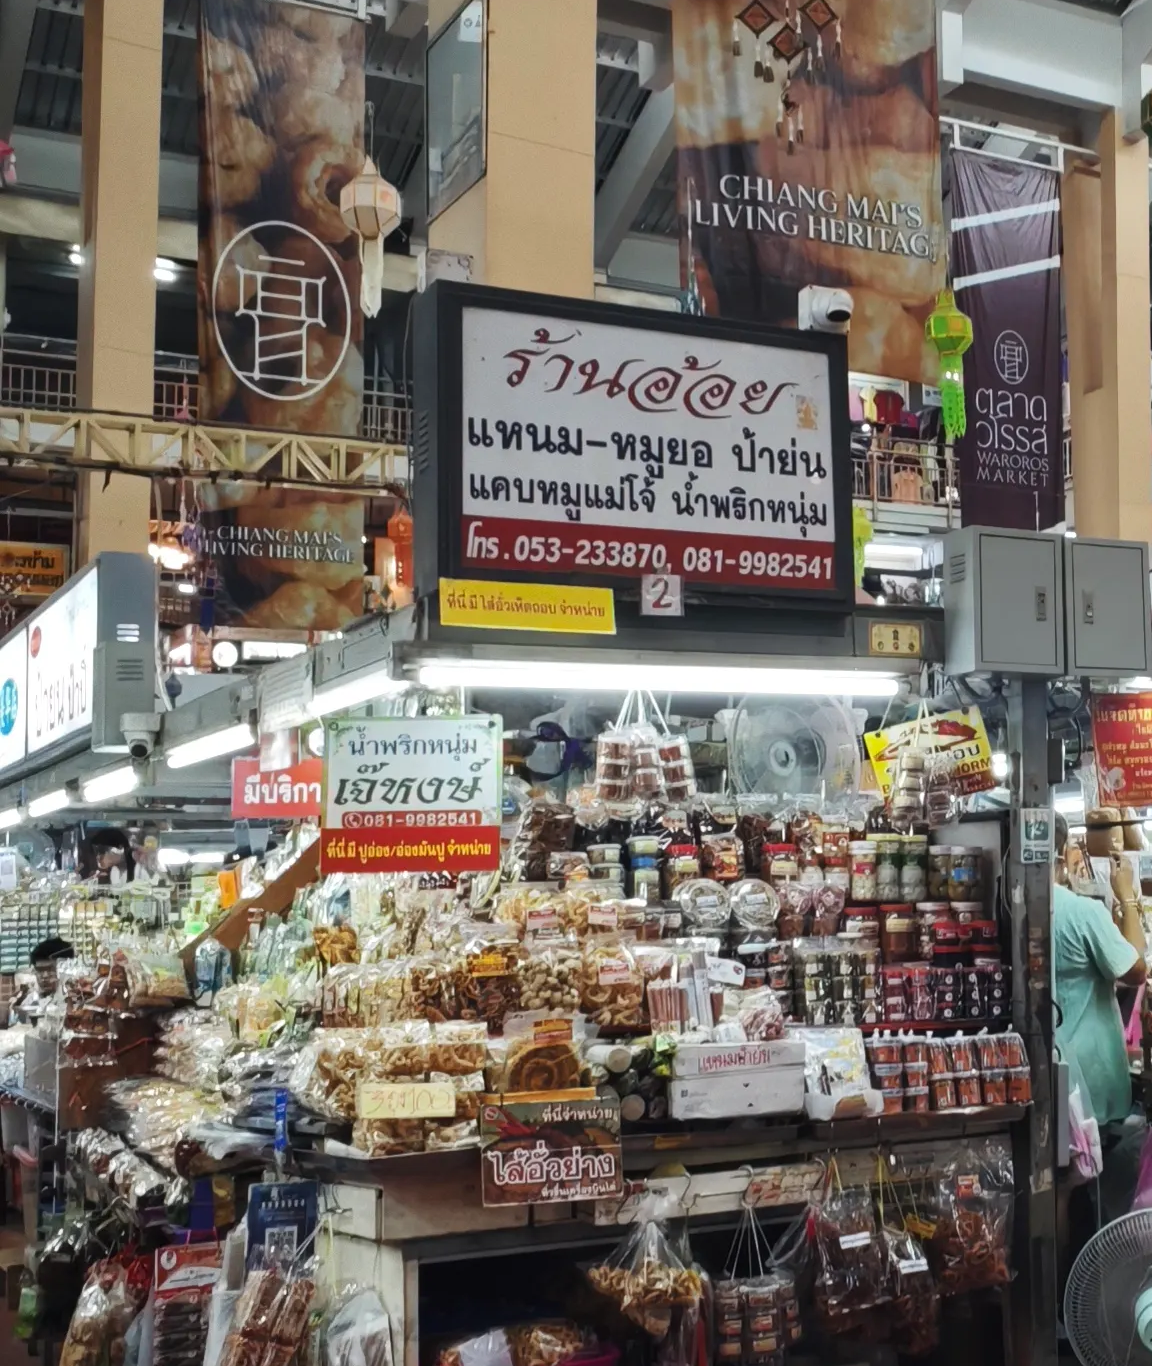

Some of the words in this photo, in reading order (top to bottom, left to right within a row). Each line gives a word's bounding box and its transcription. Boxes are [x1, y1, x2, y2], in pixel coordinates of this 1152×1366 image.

[695, 199, 798, 236] LIVING
[719, 174, 838, 213] CHIANG
[847, 194, 922, 229] MAI'S
[504, 327, 799, 419] ร้านอ้อย
[976, 388, 1047, 422] ตลาด
[467, 416, 713, 480] แหนม-หมูยอ
[731, 427, 828, 480] ป้าย่น
[976, 414, 1048, 454] วโรรส
[976, 467, 1048, 487] MARKET
[977, 451, 1049, 471] WAROROS
[469, 472, 656, 521] แคบหมูแม่โจ้
[672, 471, 828, 537] น้ำพริกหนุ่ม
[217, 526, 289, 543] CHIANG
[268, 544, 354, 564] HERITAGE
[682, 547, 833, 580] 081-9982541
[651, 577, 673, 609] 2
[349, 724, 477, 762] น้ำพริกหนุ่ม
[334, 757, 490, 805] เจ๊หงษ์
[363, 812, 477, 827] 081-9982541
[447, 839, 491, 856] จำหน่าย
[487, 1140, 616, 1186] ไส้อั่วย่าง
